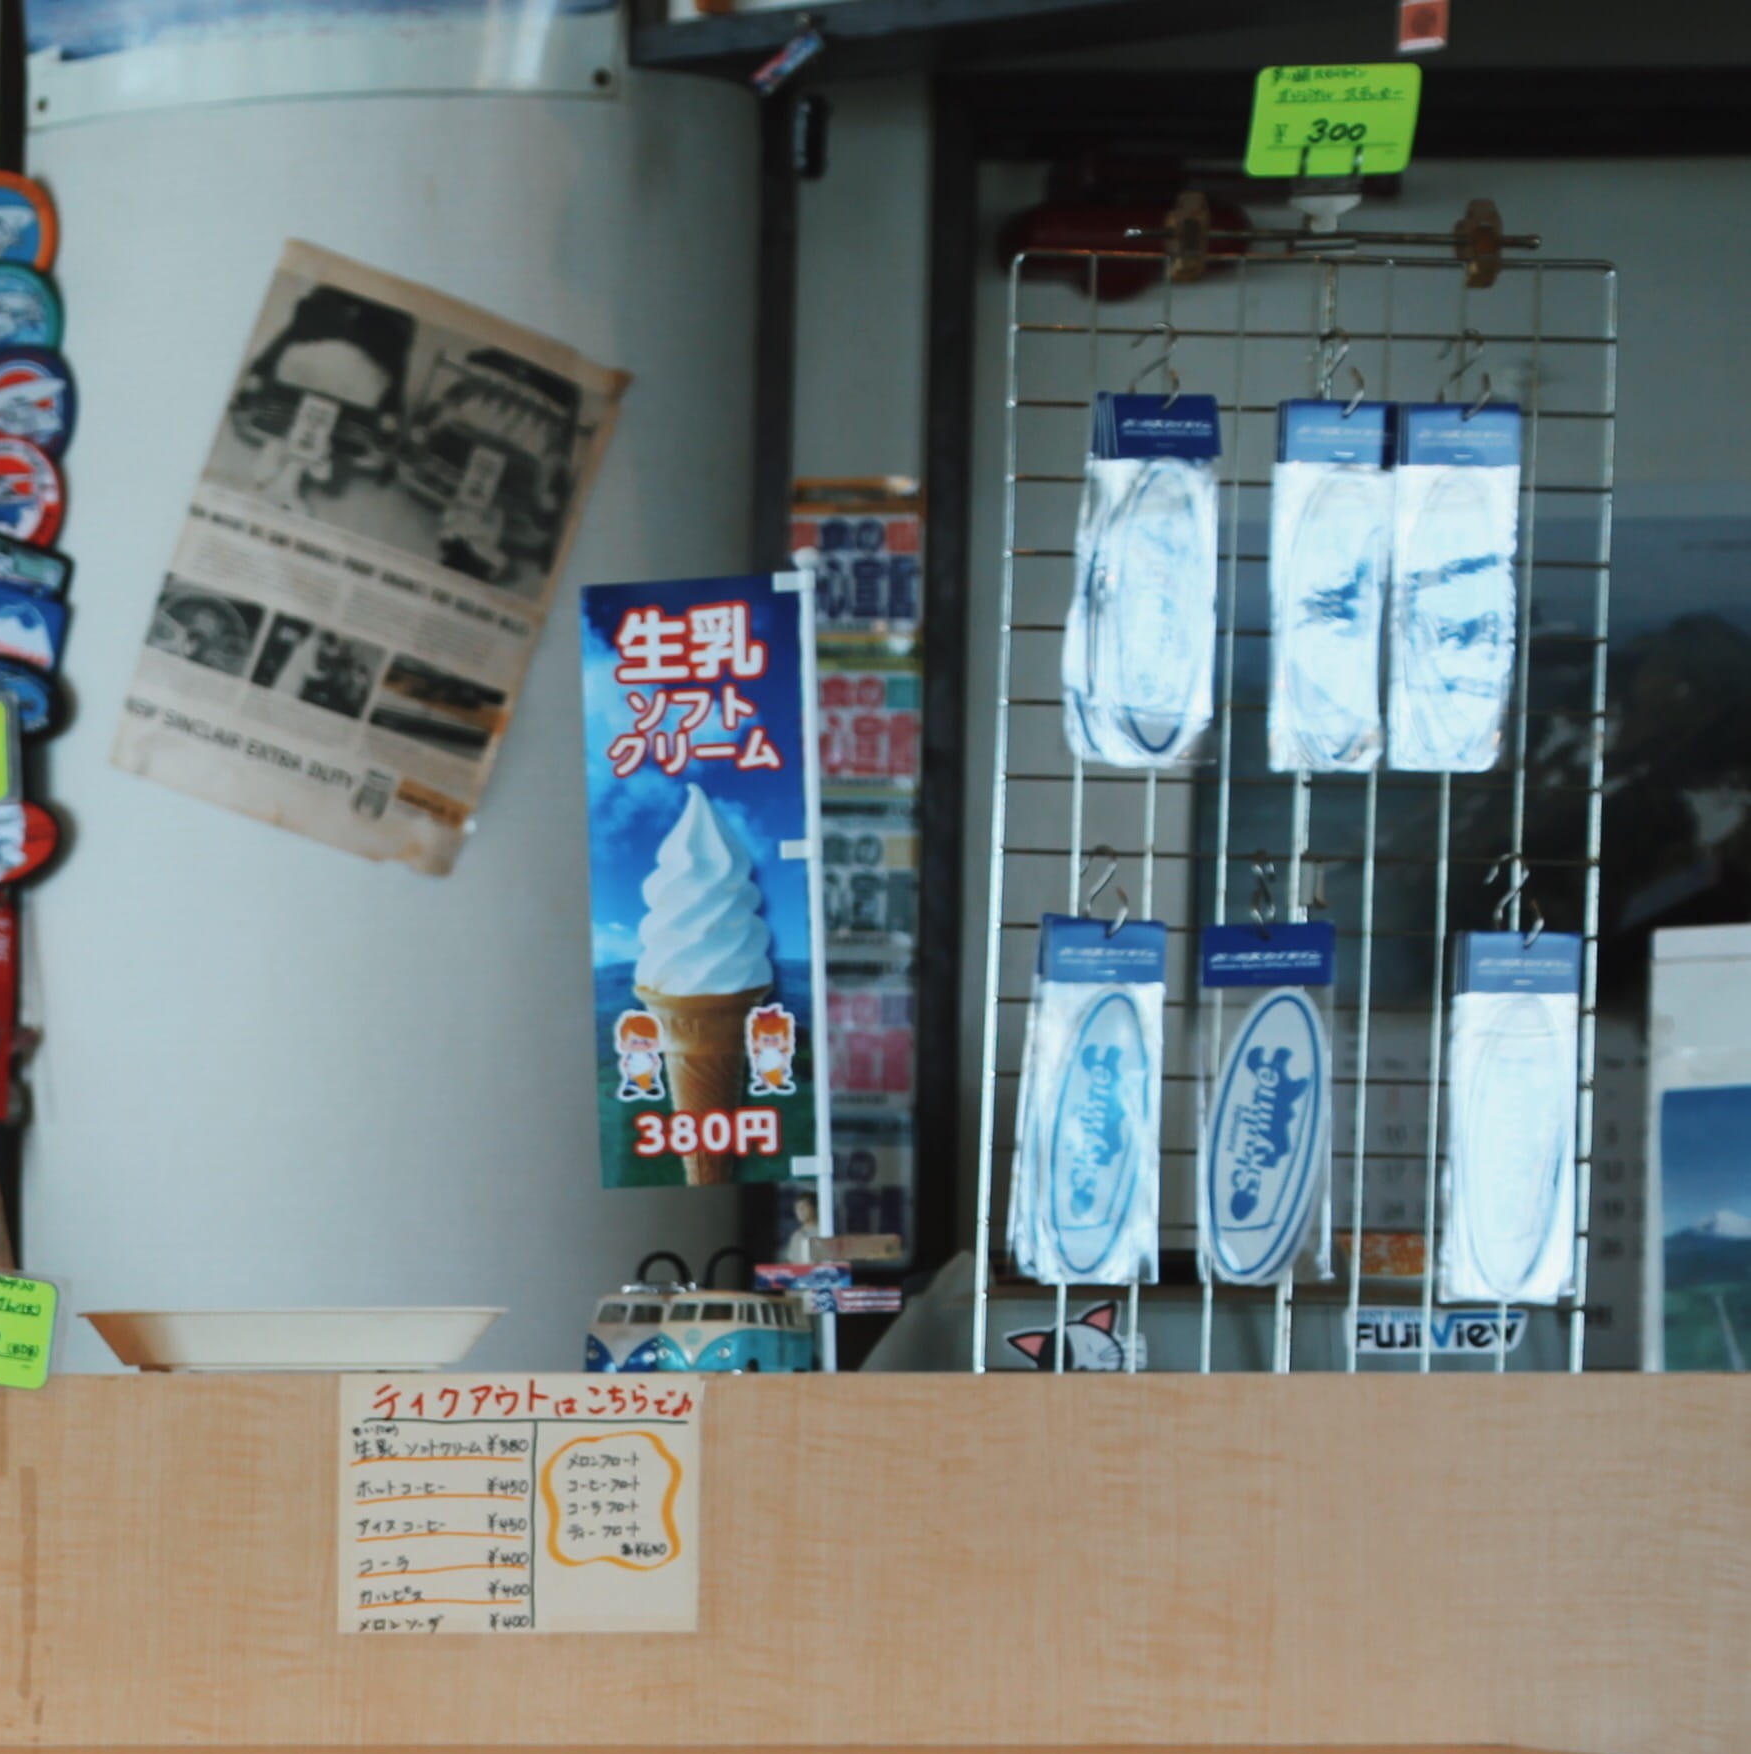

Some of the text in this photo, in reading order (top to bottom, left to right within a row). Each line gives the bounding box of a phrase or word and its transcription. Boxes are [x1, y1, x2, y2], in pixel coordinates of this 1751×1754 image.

[1308, 118, 1367, 143] 300
[615, 603, 766, 683] 生乳
[625, 686, 756, 731] ソフト
[607, 732, 781, 777] クリーム
[633, 1108, 781, 1157] 380円
[354, 1438, 400, 1458] 生乳
[486, 1434, 529, 1455] ¥380
[359, 1547, 529, 1573] コーラ ¥400
[359, 1579, 529, 1604] カルピス ¥400
[359, 1611, 529, 1632] メロンソーダ ¥400
